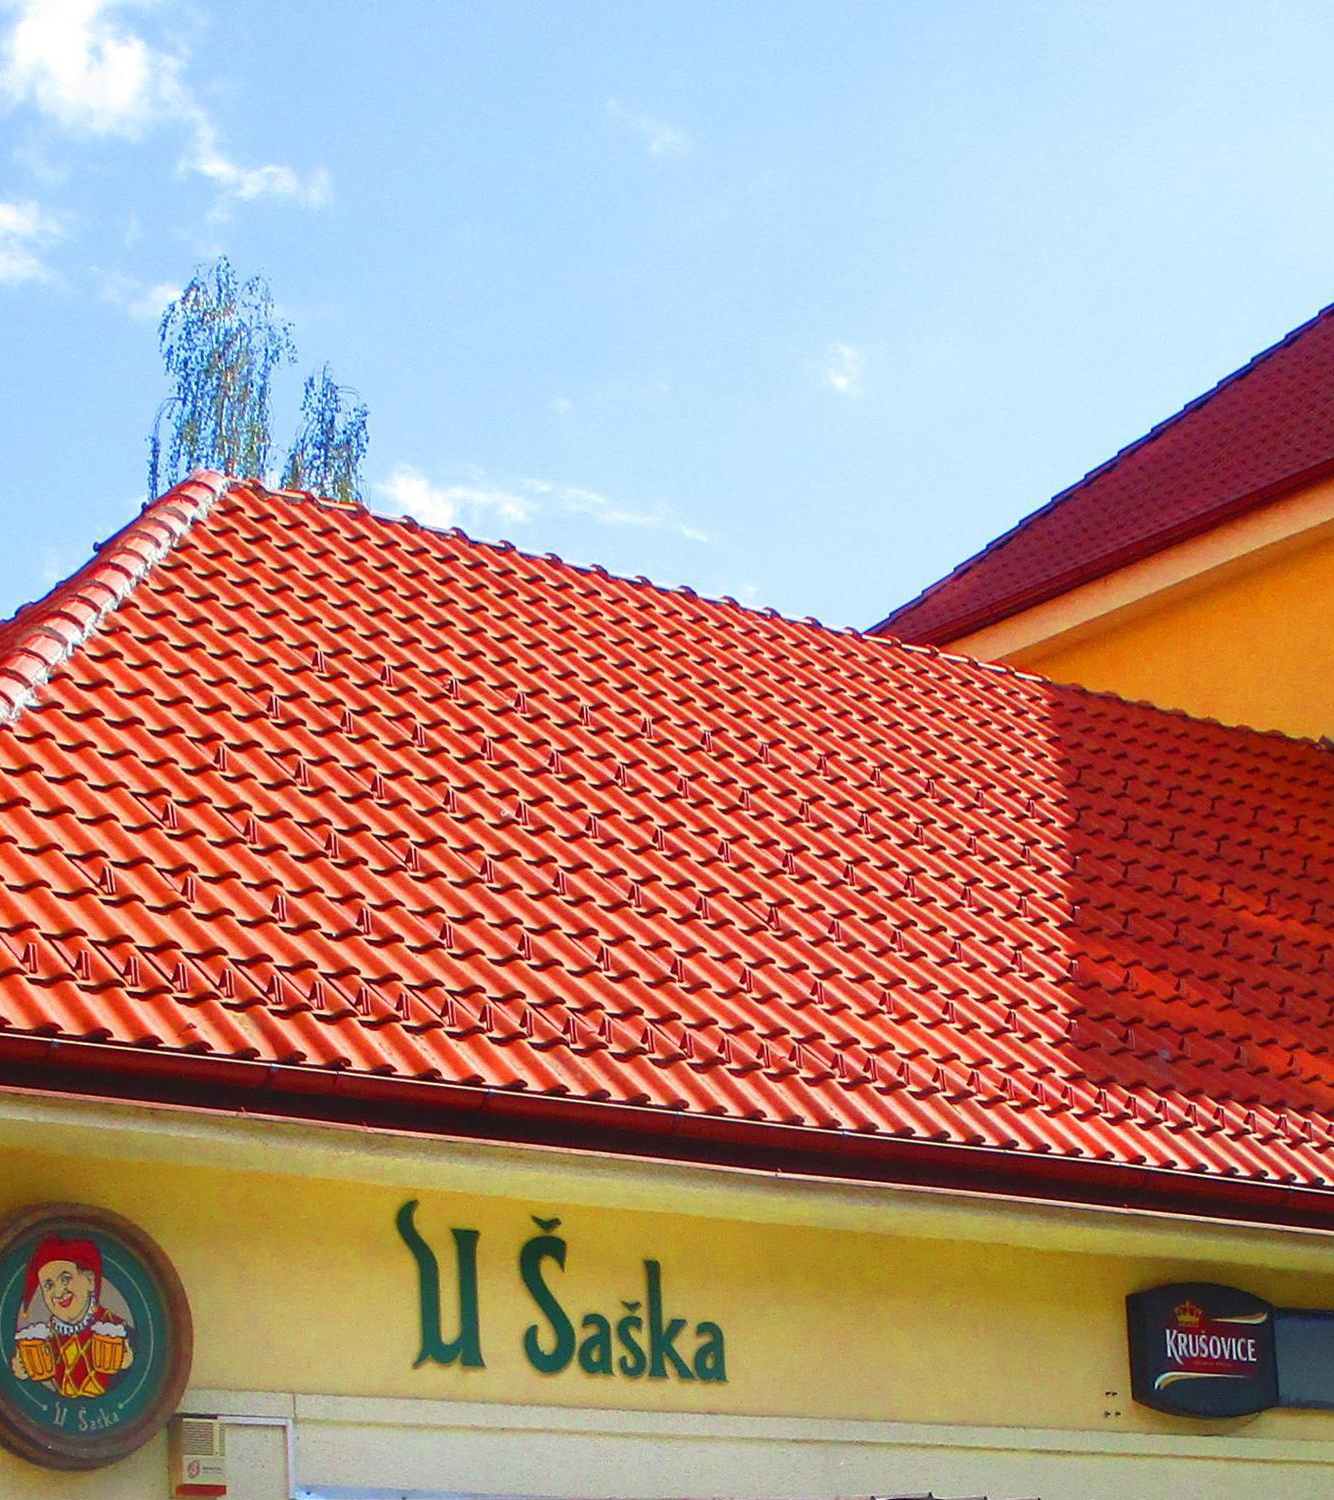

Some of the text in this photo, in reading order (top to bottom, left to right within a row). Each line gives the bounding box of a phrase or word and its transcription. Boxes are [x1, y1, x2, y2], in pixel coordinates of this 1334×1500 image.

[395, 1199, 728, 1383] U Šaška
[1165, 1328, 1258, 1365] KRUŠOVICE
[52, 1401, 68, 1427] U
